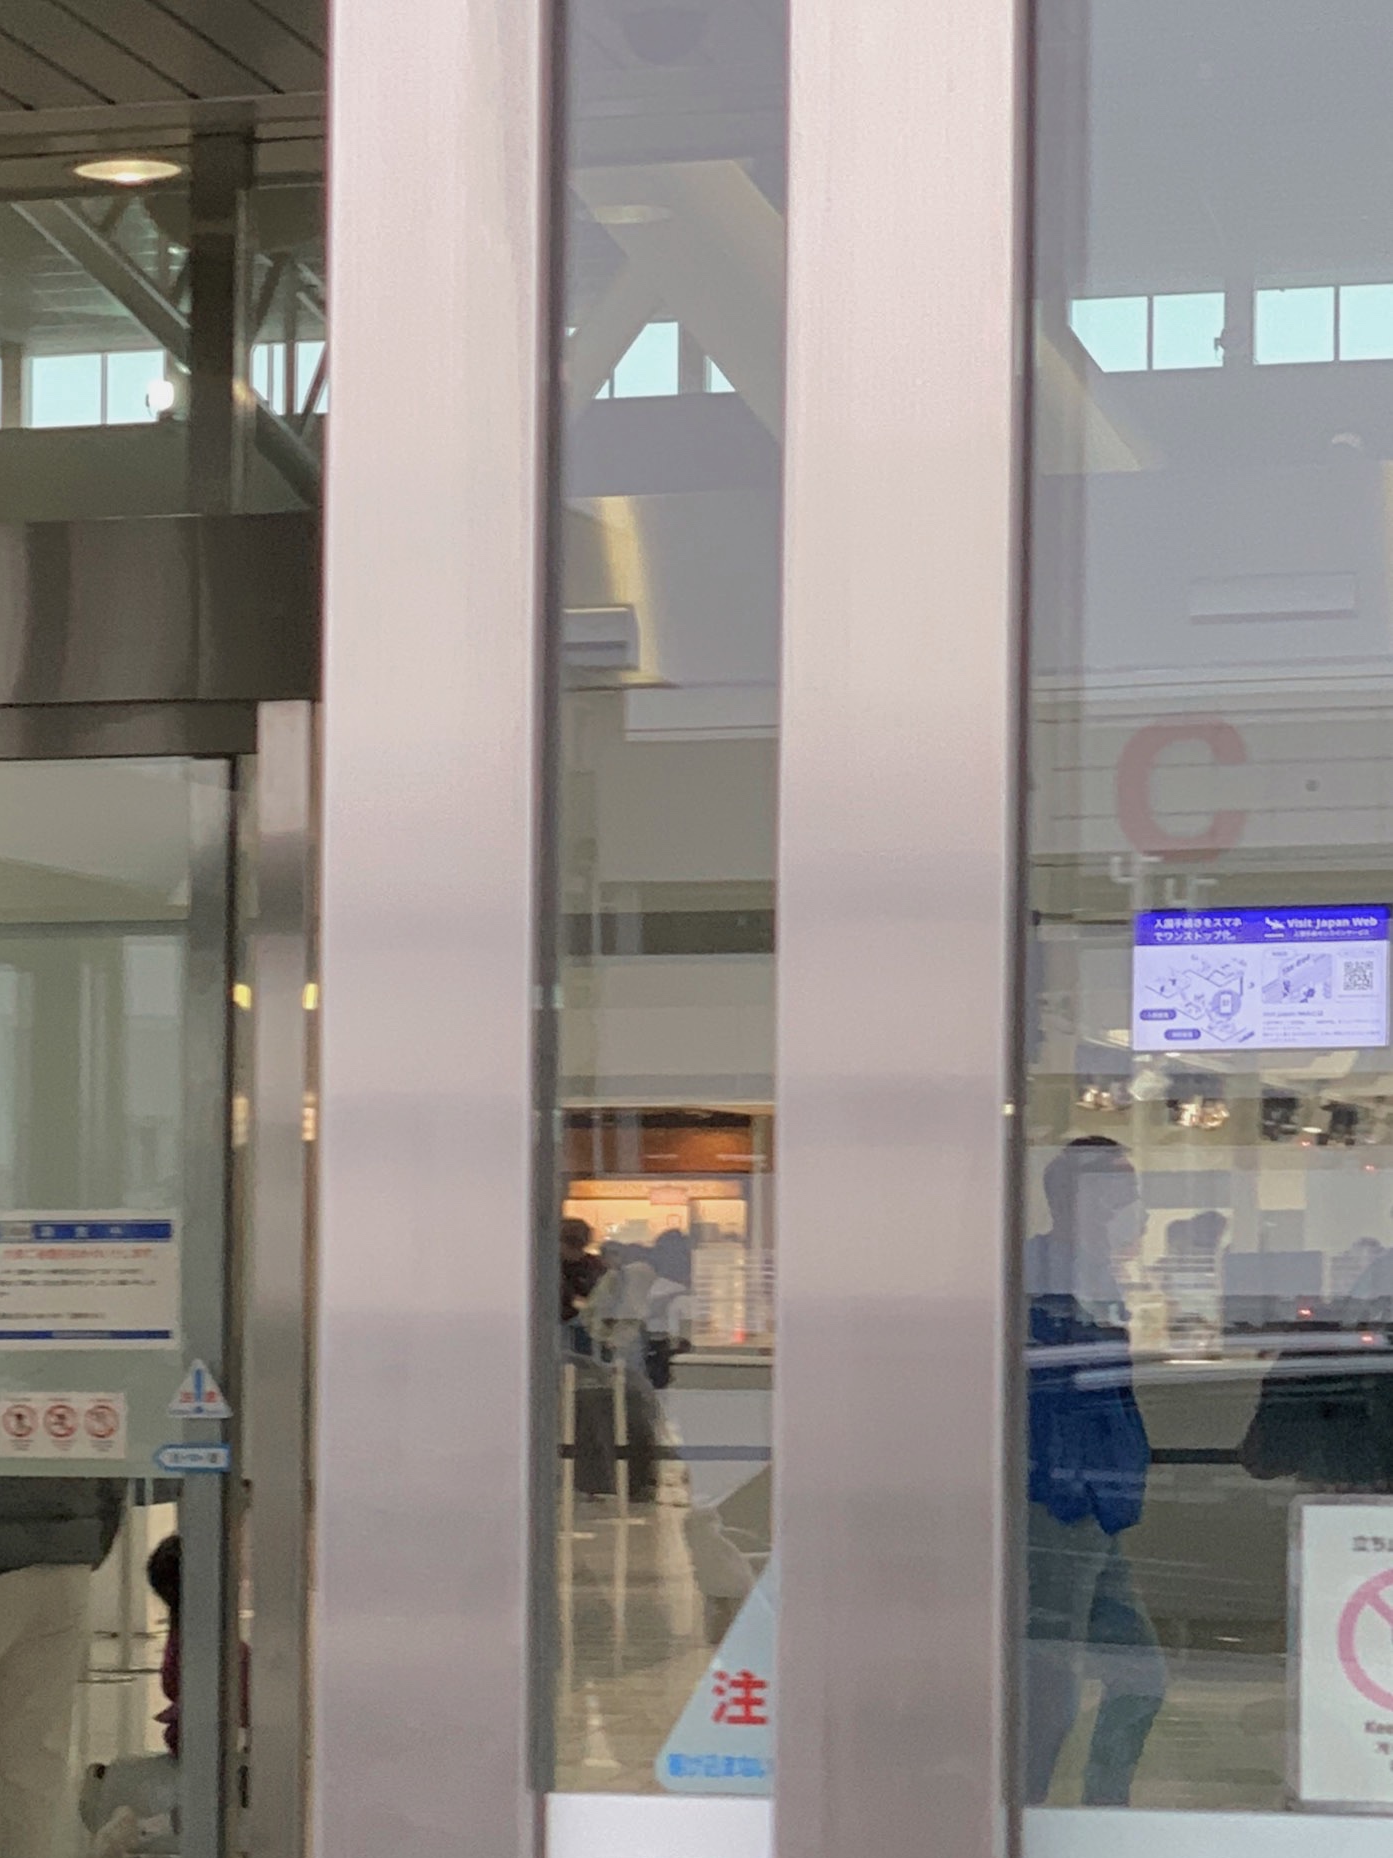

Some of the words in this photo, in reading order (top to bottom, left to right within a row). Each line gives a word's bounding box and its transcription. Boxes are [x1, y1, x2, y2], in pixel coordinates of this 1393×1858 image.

[1116, 712, 1249, 863] C
[1286, 918, 1312, 928] Visit
[1315, 918, 1350, 930] Japan
[1351, 916, 1379, 927] Web
[711, 1665, 769, 1725] 注
